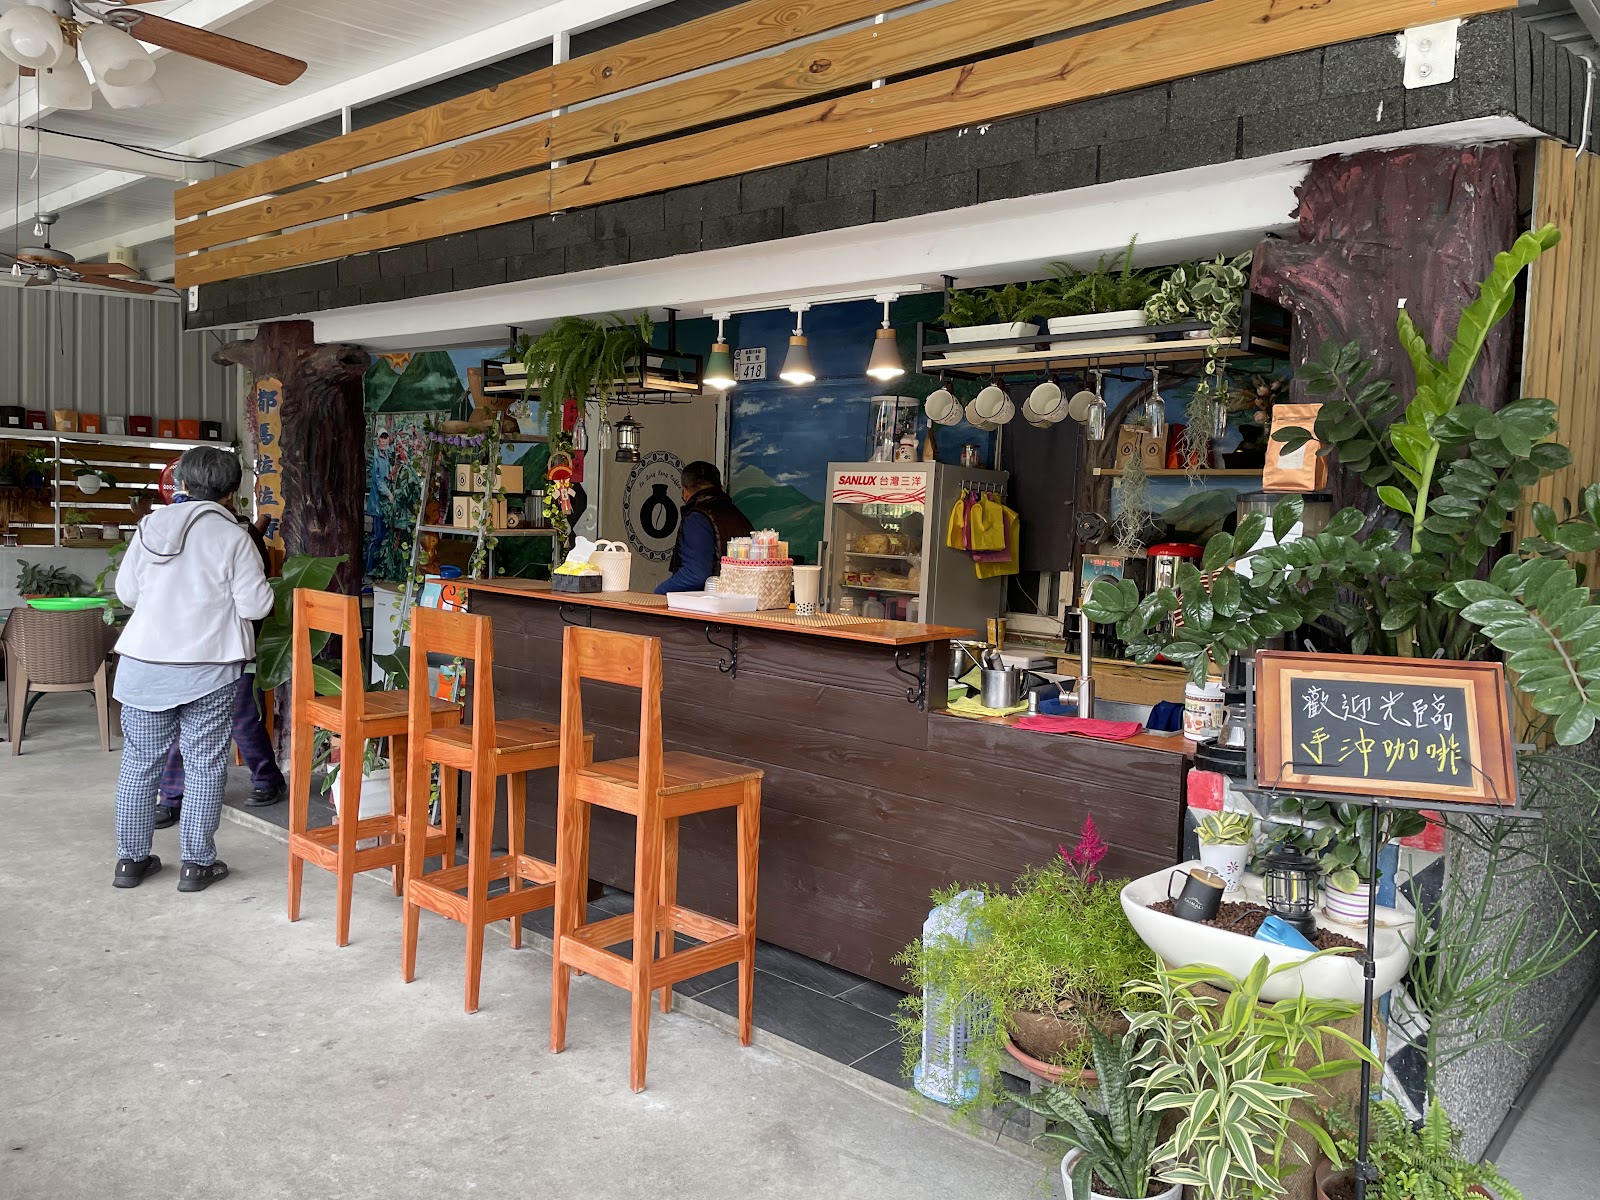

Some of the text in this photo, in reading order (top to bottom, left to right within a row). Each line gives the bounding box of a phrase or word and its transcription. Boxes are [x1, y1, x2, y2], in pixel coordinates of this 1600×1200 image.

[744, 365, 762, 378] 418
[838, 475, 922, 486] SANLUX 台灣三洋
[1302, 685, 1454, 731] 歡迎光臨
[1300, 726, 1462, 776] 手沖咖啡
